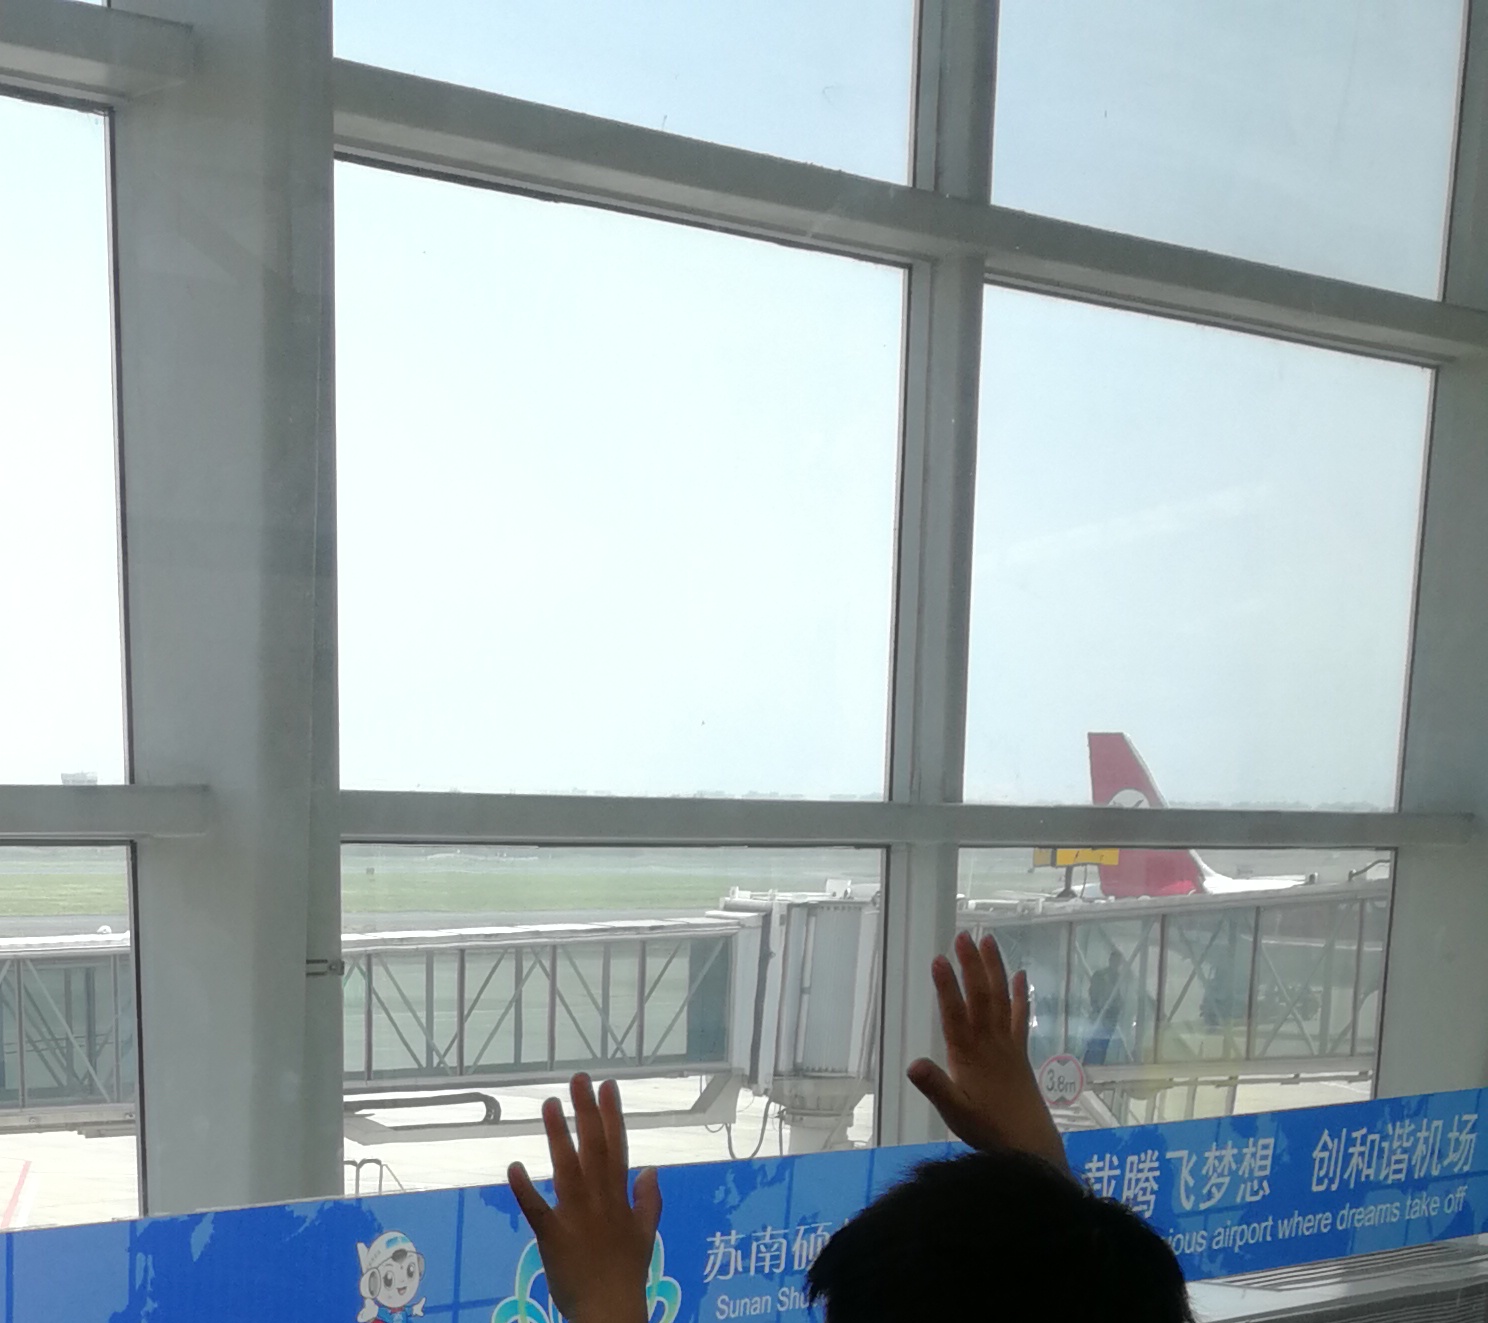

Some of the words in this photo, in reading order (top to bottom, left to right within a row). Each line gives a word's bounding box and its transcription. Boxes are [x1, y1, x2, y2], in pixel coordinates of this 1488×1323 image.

[1046, 1068, 1077, 1093] 3.8m
[703, 1222, 834, 1283] 苏南硕
[1312, 1113, 1478, 1192] 创和谐机场
[716, 1295, 772, 1320] Sunan
[777, 1286, 814, 1312] Shu
[1164, 1228, 1209, 1255] ious
[1213, 1216, 1274, 1252] airport
[1278, 1210, 1332, 1240] where
[1336, 1203, 1401, 1231] dreams
[1405, 1192, 1440, 1220] take
[1444, 1185, 1468, 1214] off
